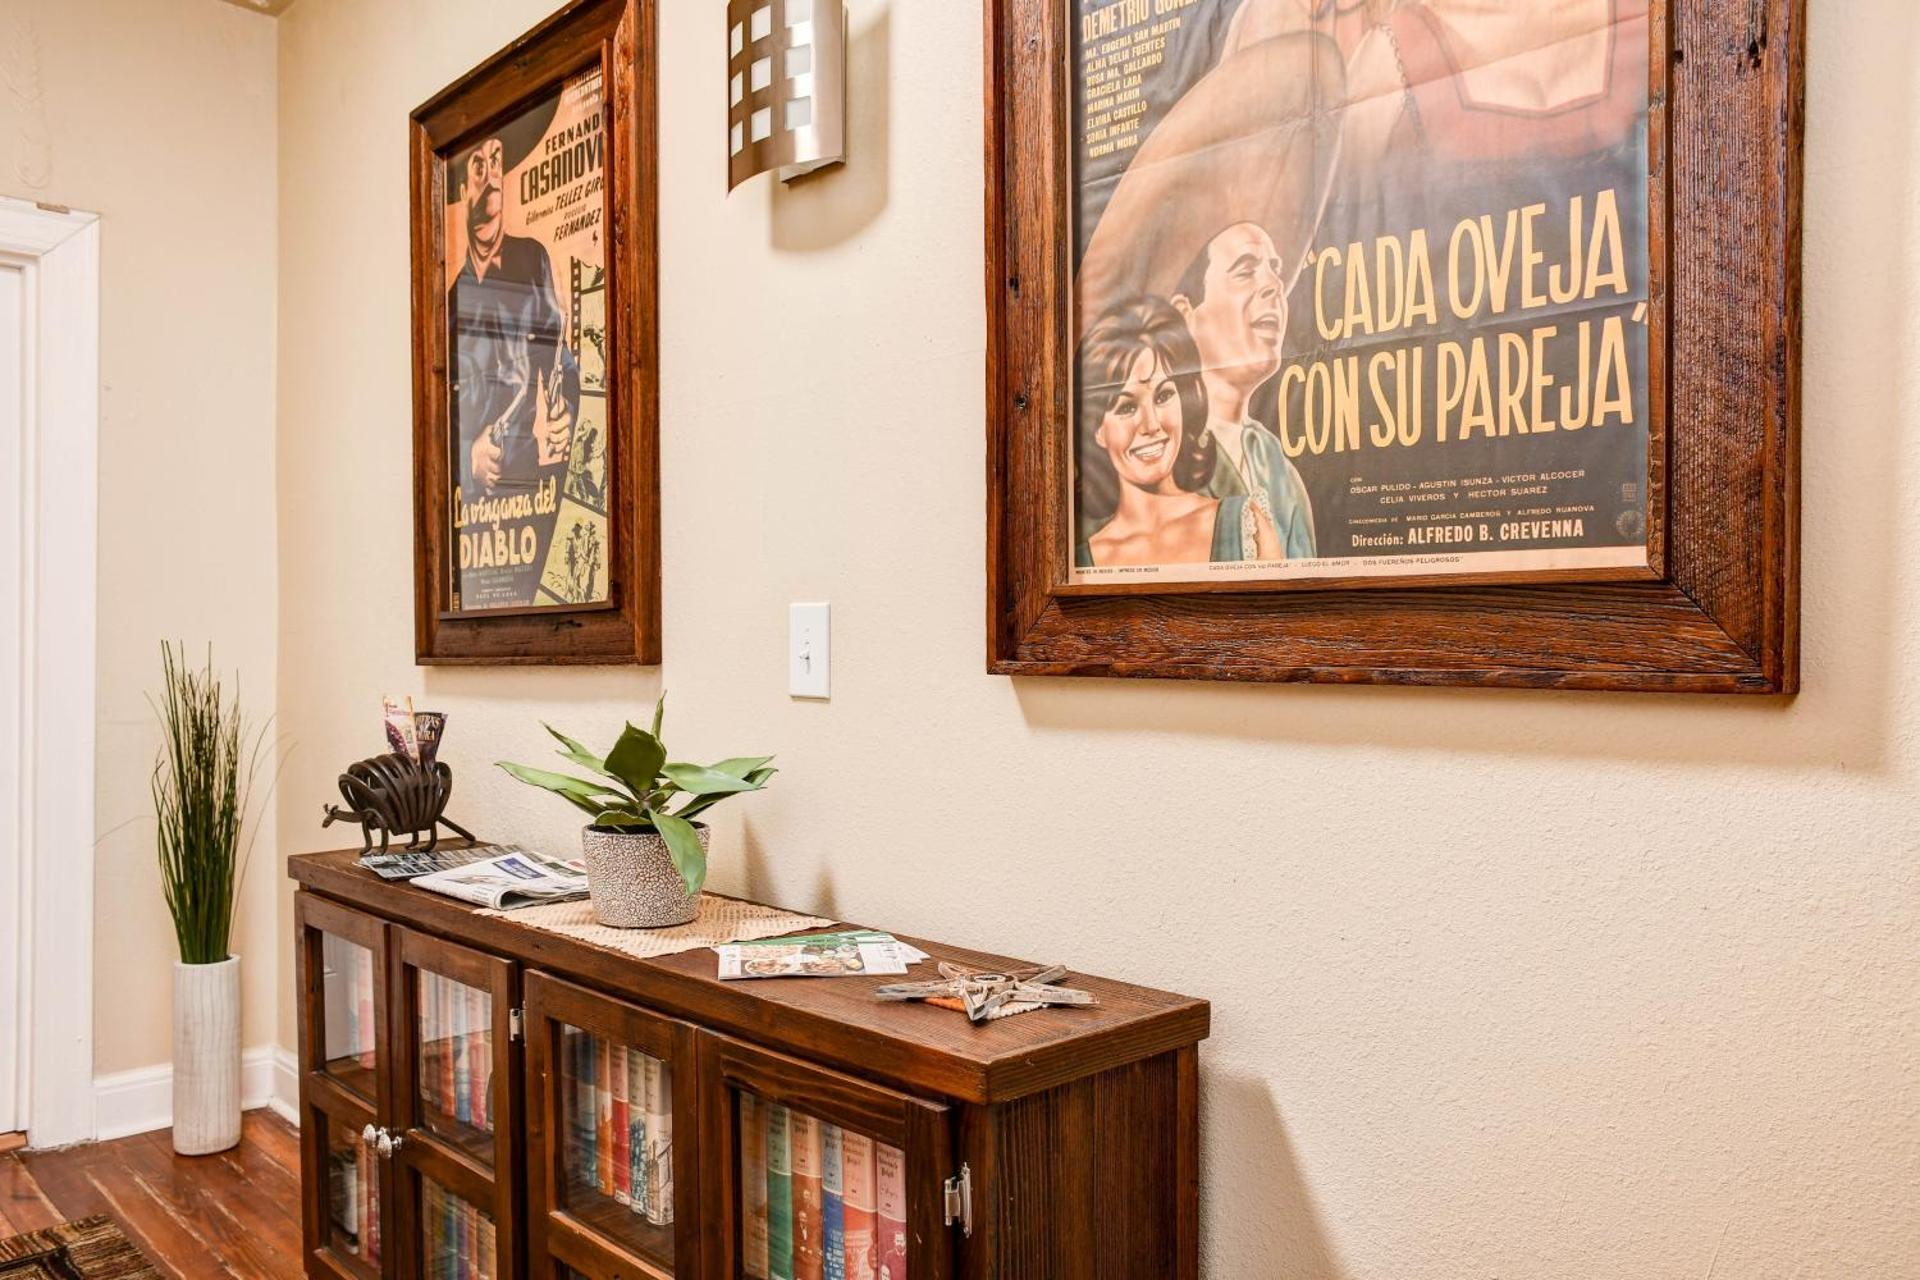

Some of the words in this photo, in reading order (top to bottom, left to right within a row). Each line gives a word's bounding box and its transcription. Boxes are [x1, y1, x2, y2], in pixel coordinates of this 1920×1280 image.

[1082, 0, 1149, 43] DEMETRIO
[1086, 58, 1106, 73] ALMA
[1132, 37, 1165, 57] FUENTES
[1101, 35, 1132, 54] EUGENIA
[1134, 28, 1149, 42] SAN
[1123, 53, 1162, 74] GALLARDO
[1087, 80, 1120, 99] GRACIELA
[1113, 100, 1148, 120] CASTILLO
[545, 110, 603, 156] FERNAND
[1109, 118, 1140, 136] INFANTE
[555, 184, 583, 211] TELLEZ
[553, 207, 601, 242] FERNANDEZ
[1448, 189, 1628, 320] OVEJA
[1278, 356, 1360, 458] CON
[1368, 346, 1423, 448] SU
[1350, 485, 1377, 494] OSCAR
[1381, 483, 1411, 492] PULIDO
[1419, 480, 1457, 490] AGUSTIN
[1461, 477, 1493, 486] ISUNZA
[1502, 474, 1536, 483] VICTOR
[1540, 470, 1586, 481] ALCOCER
[1380, 496, 1404, 504] CELIA
[1408, 493, 1447, 502] VIVEROS
[1468, 489, 1506, 498] HECTOR
[1511, 486, 1549, 496] SUAREZ
[470, 494, 532, 531] venganza
[534, 474, 557, 515] del
[1517, 507, 1552, 516] ALFREDO
[1352, 533, 1404, 547] Dirección:
[1408, 524, 1473, 544] ALFREDO
[1479, 524, 1494, 541] B.
[1500, 518, 1584, 541] CREVENNA
[460, 525, 537, 570] DIABLO
